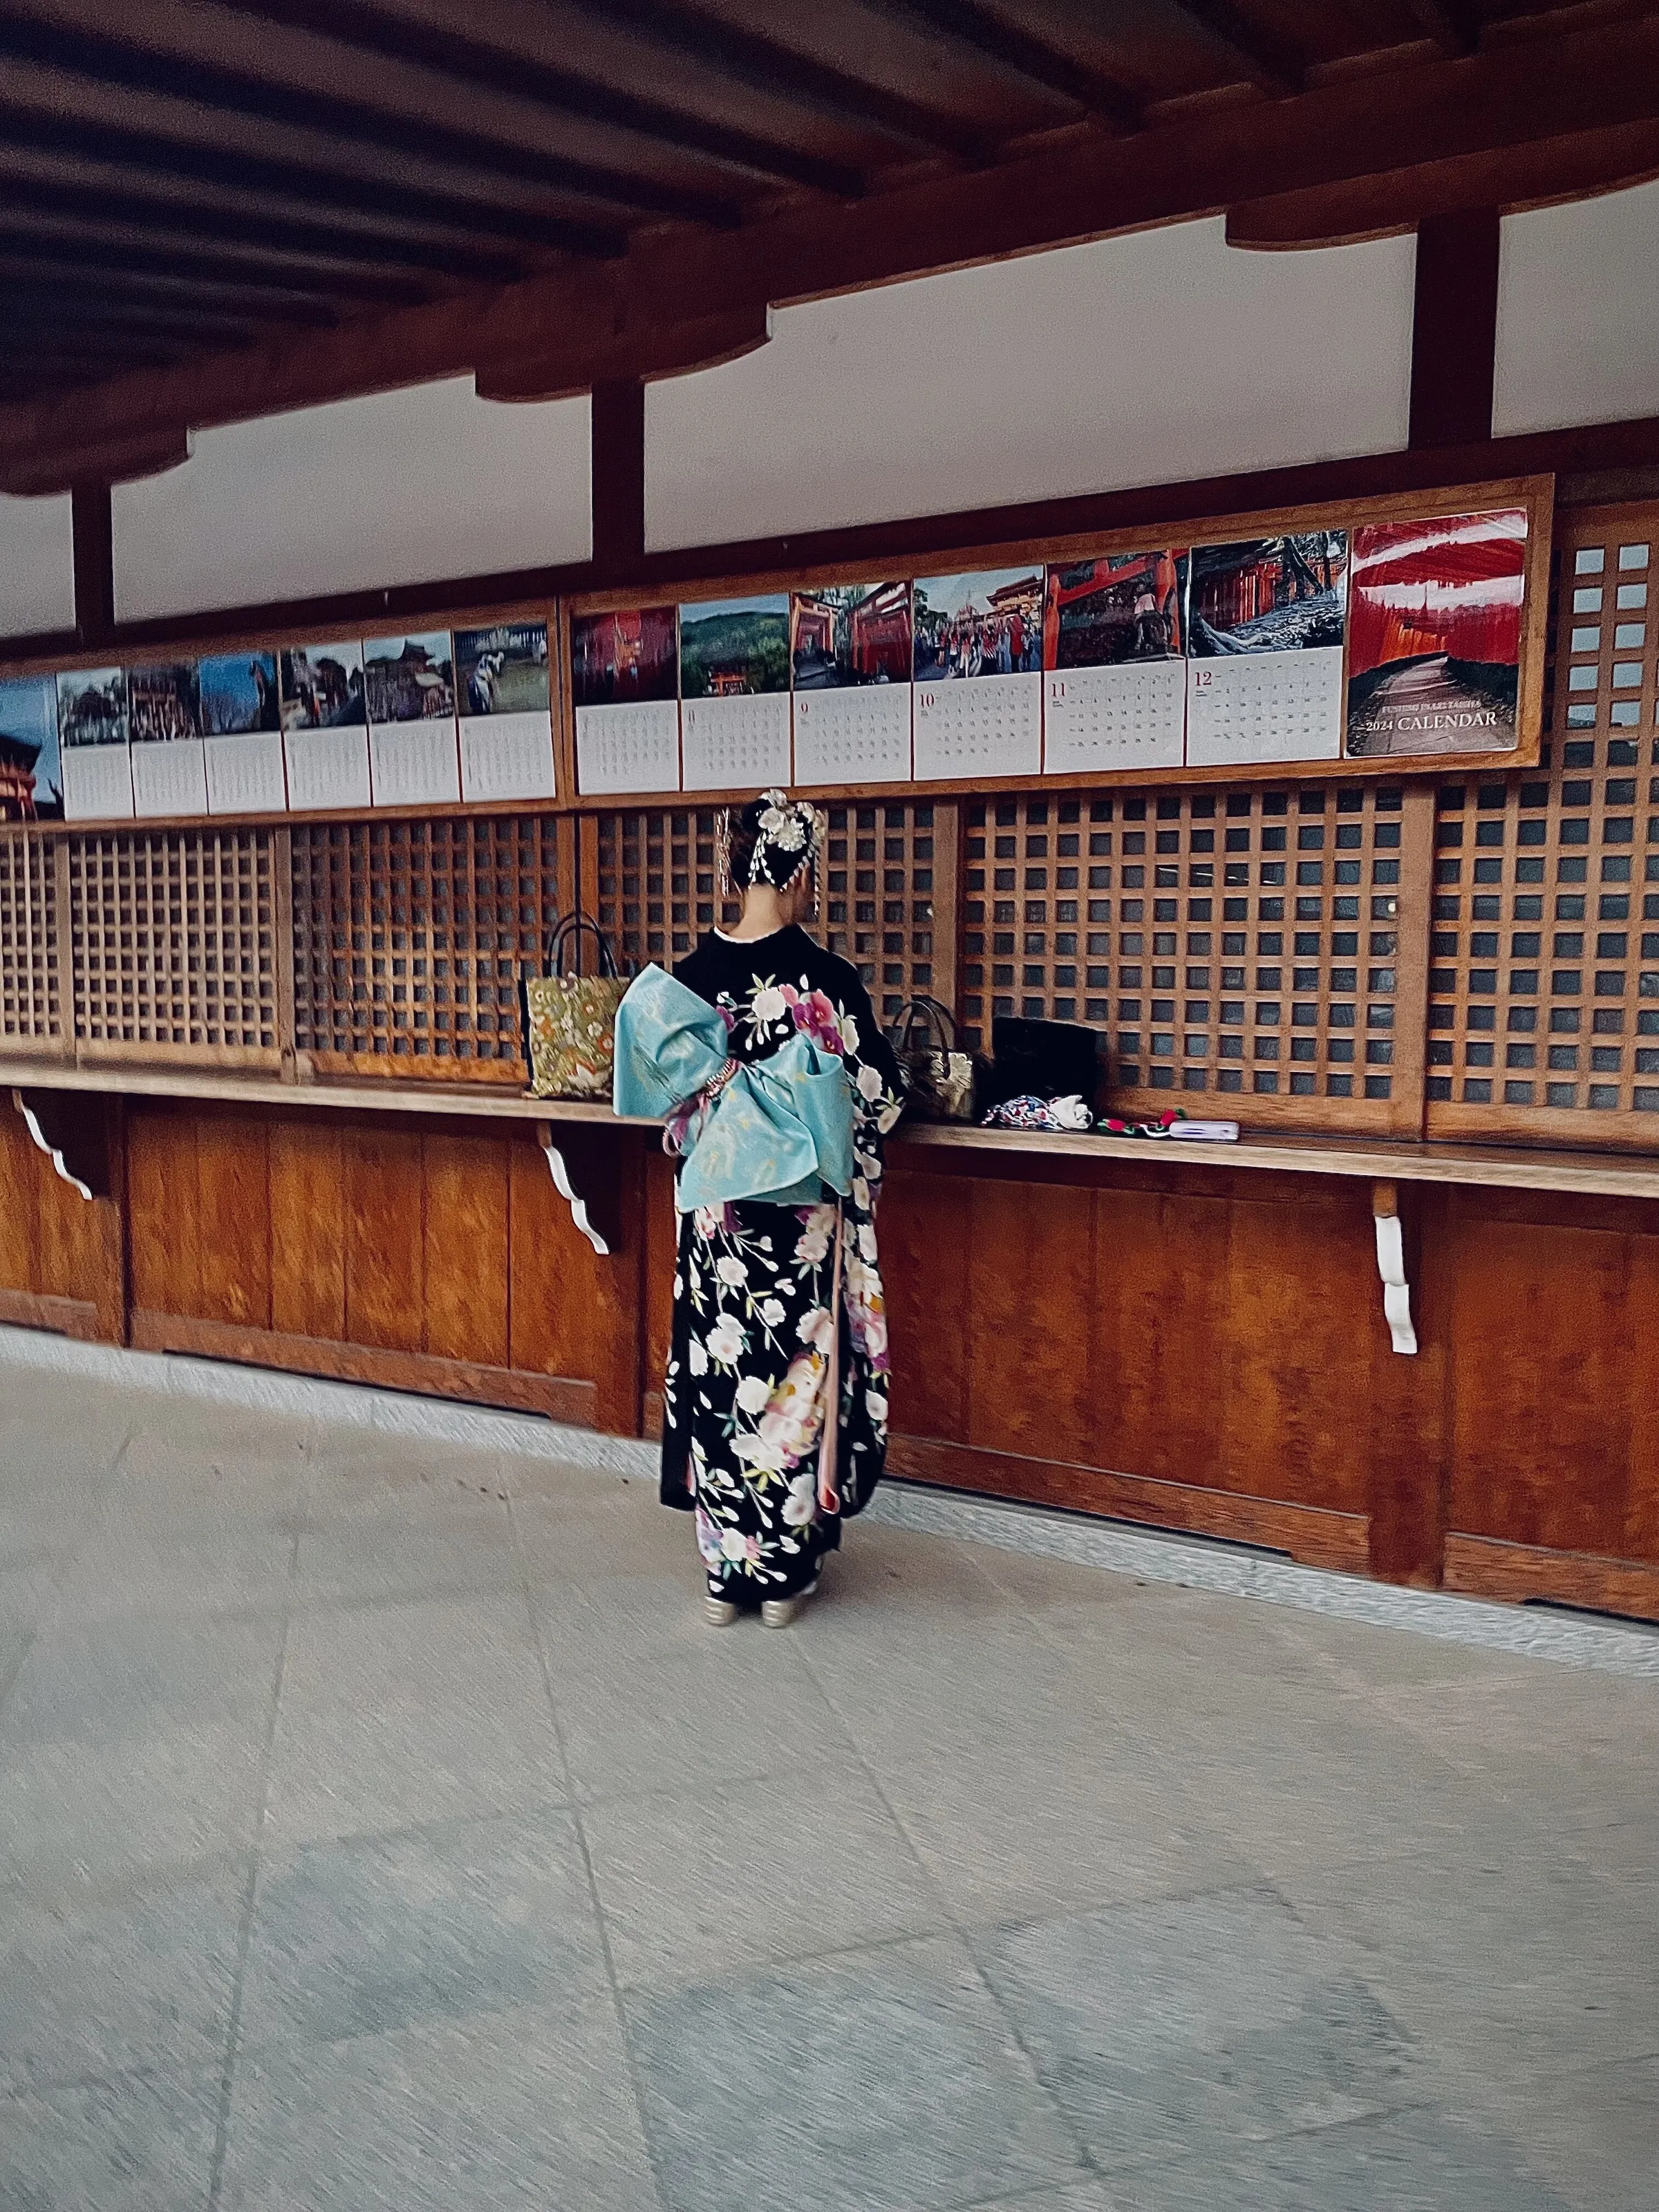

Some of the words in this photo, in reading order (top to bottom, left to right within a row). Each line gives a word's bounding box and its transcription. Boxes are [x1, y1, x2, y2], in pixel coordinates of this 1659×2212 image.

[1194, 671, 1212, 686] 12
[1051, 682, 1065, 697] 11
[920, 693, 935, 709] 10
[1366, 720, 1394, 731] 2024
[1397, 711, 1497, 731] CALENDAR
